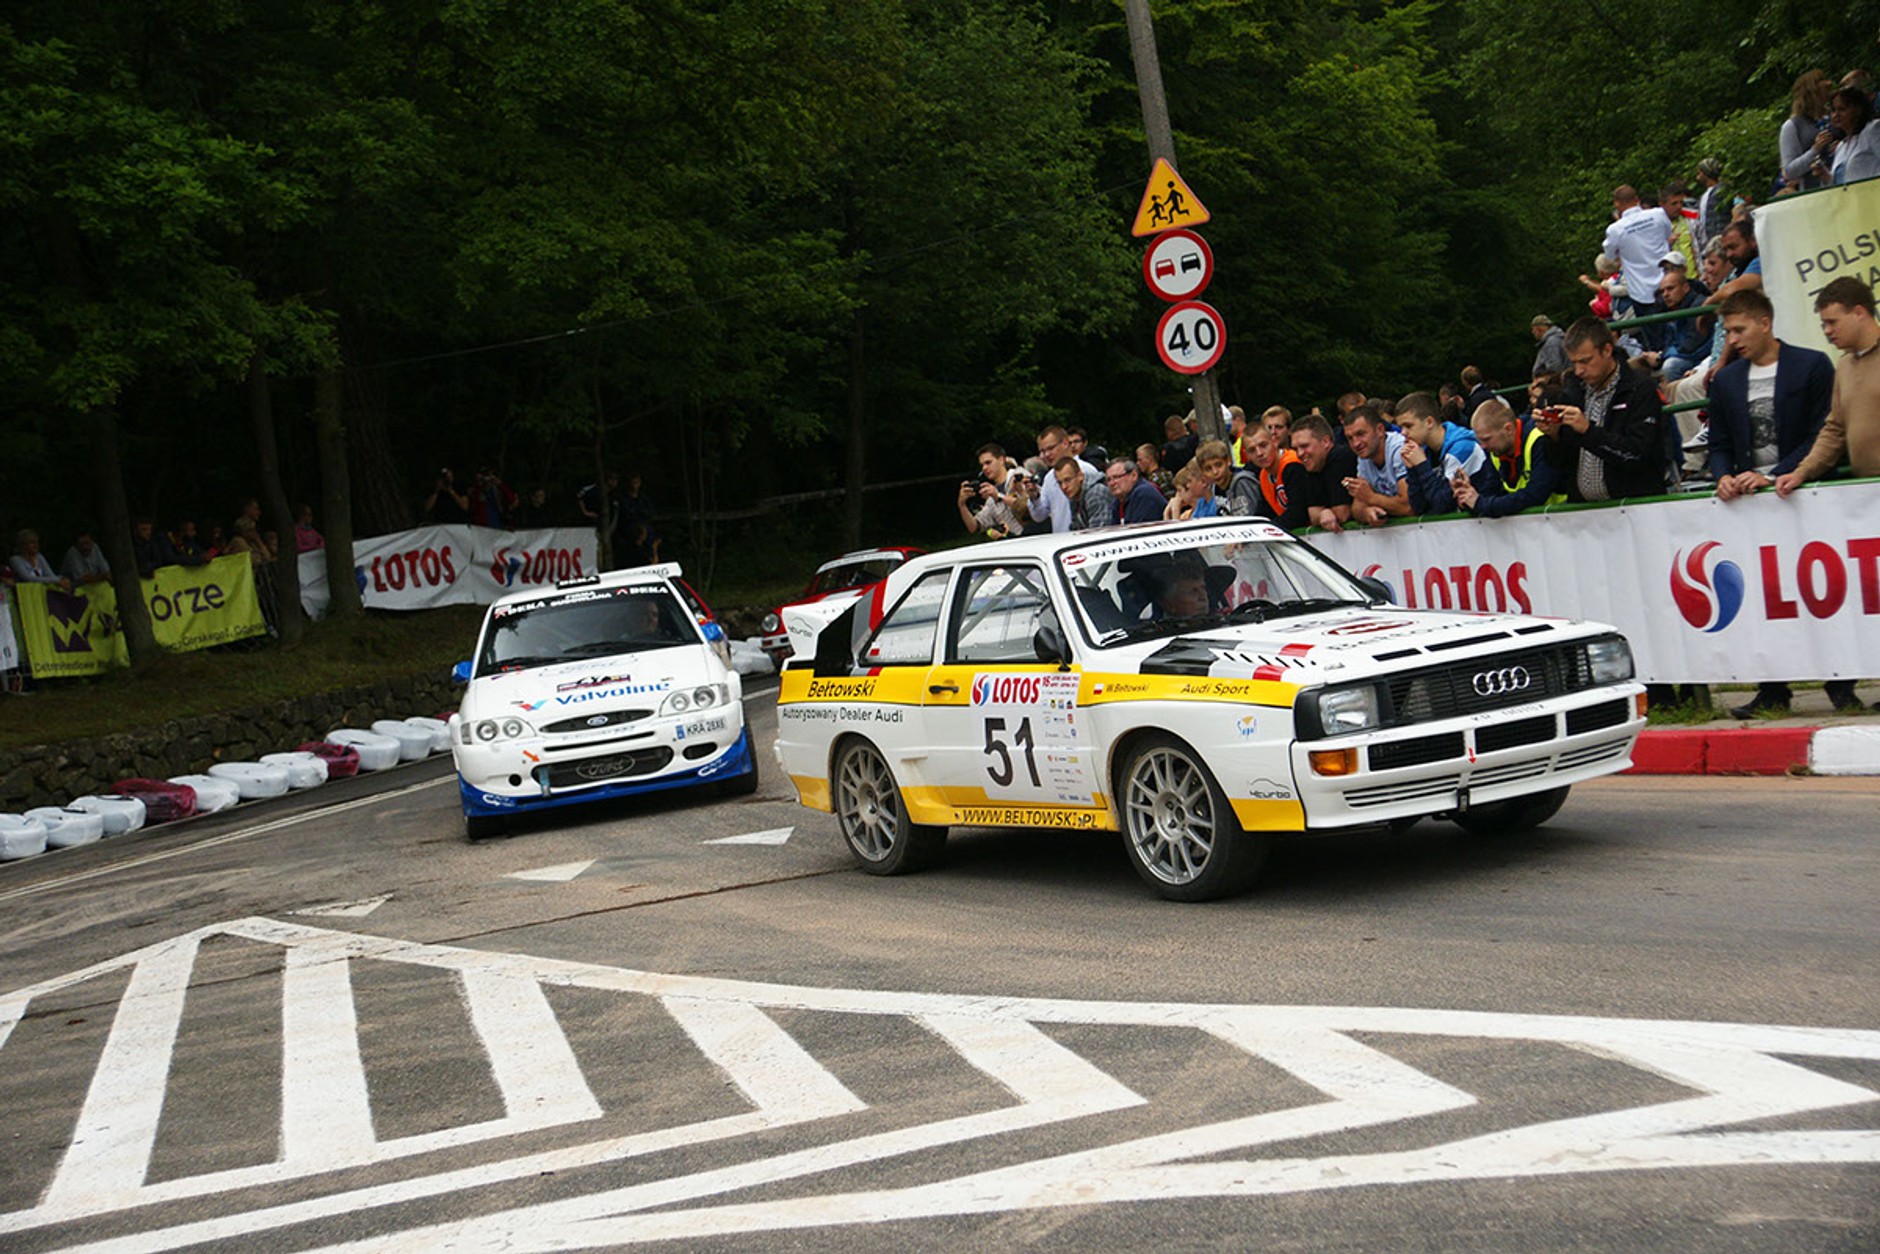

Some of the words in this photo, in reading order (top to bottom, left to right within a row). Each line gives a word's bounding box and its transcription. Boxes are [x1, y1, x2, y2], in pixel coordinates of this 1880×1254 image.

[1168, 317, 1217, 356] 40
[371, 545, 456, 593] LOTOS
[521, 547, 583, 584] LOTOS
[629, 585, 669, 595] DEKA
[1402, 561, 1532, 615] LOTOS
[1759, 537, 1880, 620] LOT
[508, 600, 546, 615] DEKA
[555, 682, 671, 706] Valvoline
[807, 680, 877, 698] Bełtowski
[992, 677, 1041, 704] LOTOS
[1180, 683, 1211, 694] Audi
[1212, 683, 1250, 696] Sport
[782, 707, 838, 722] Autoryzowany
[839, 707, 872, 721] Dealer
[874, 709, 904, 723] Audi
[983, 716, 1042, 788] 51
[962, 809, 1098, 828] WWW.BELTOWSKI.PL
